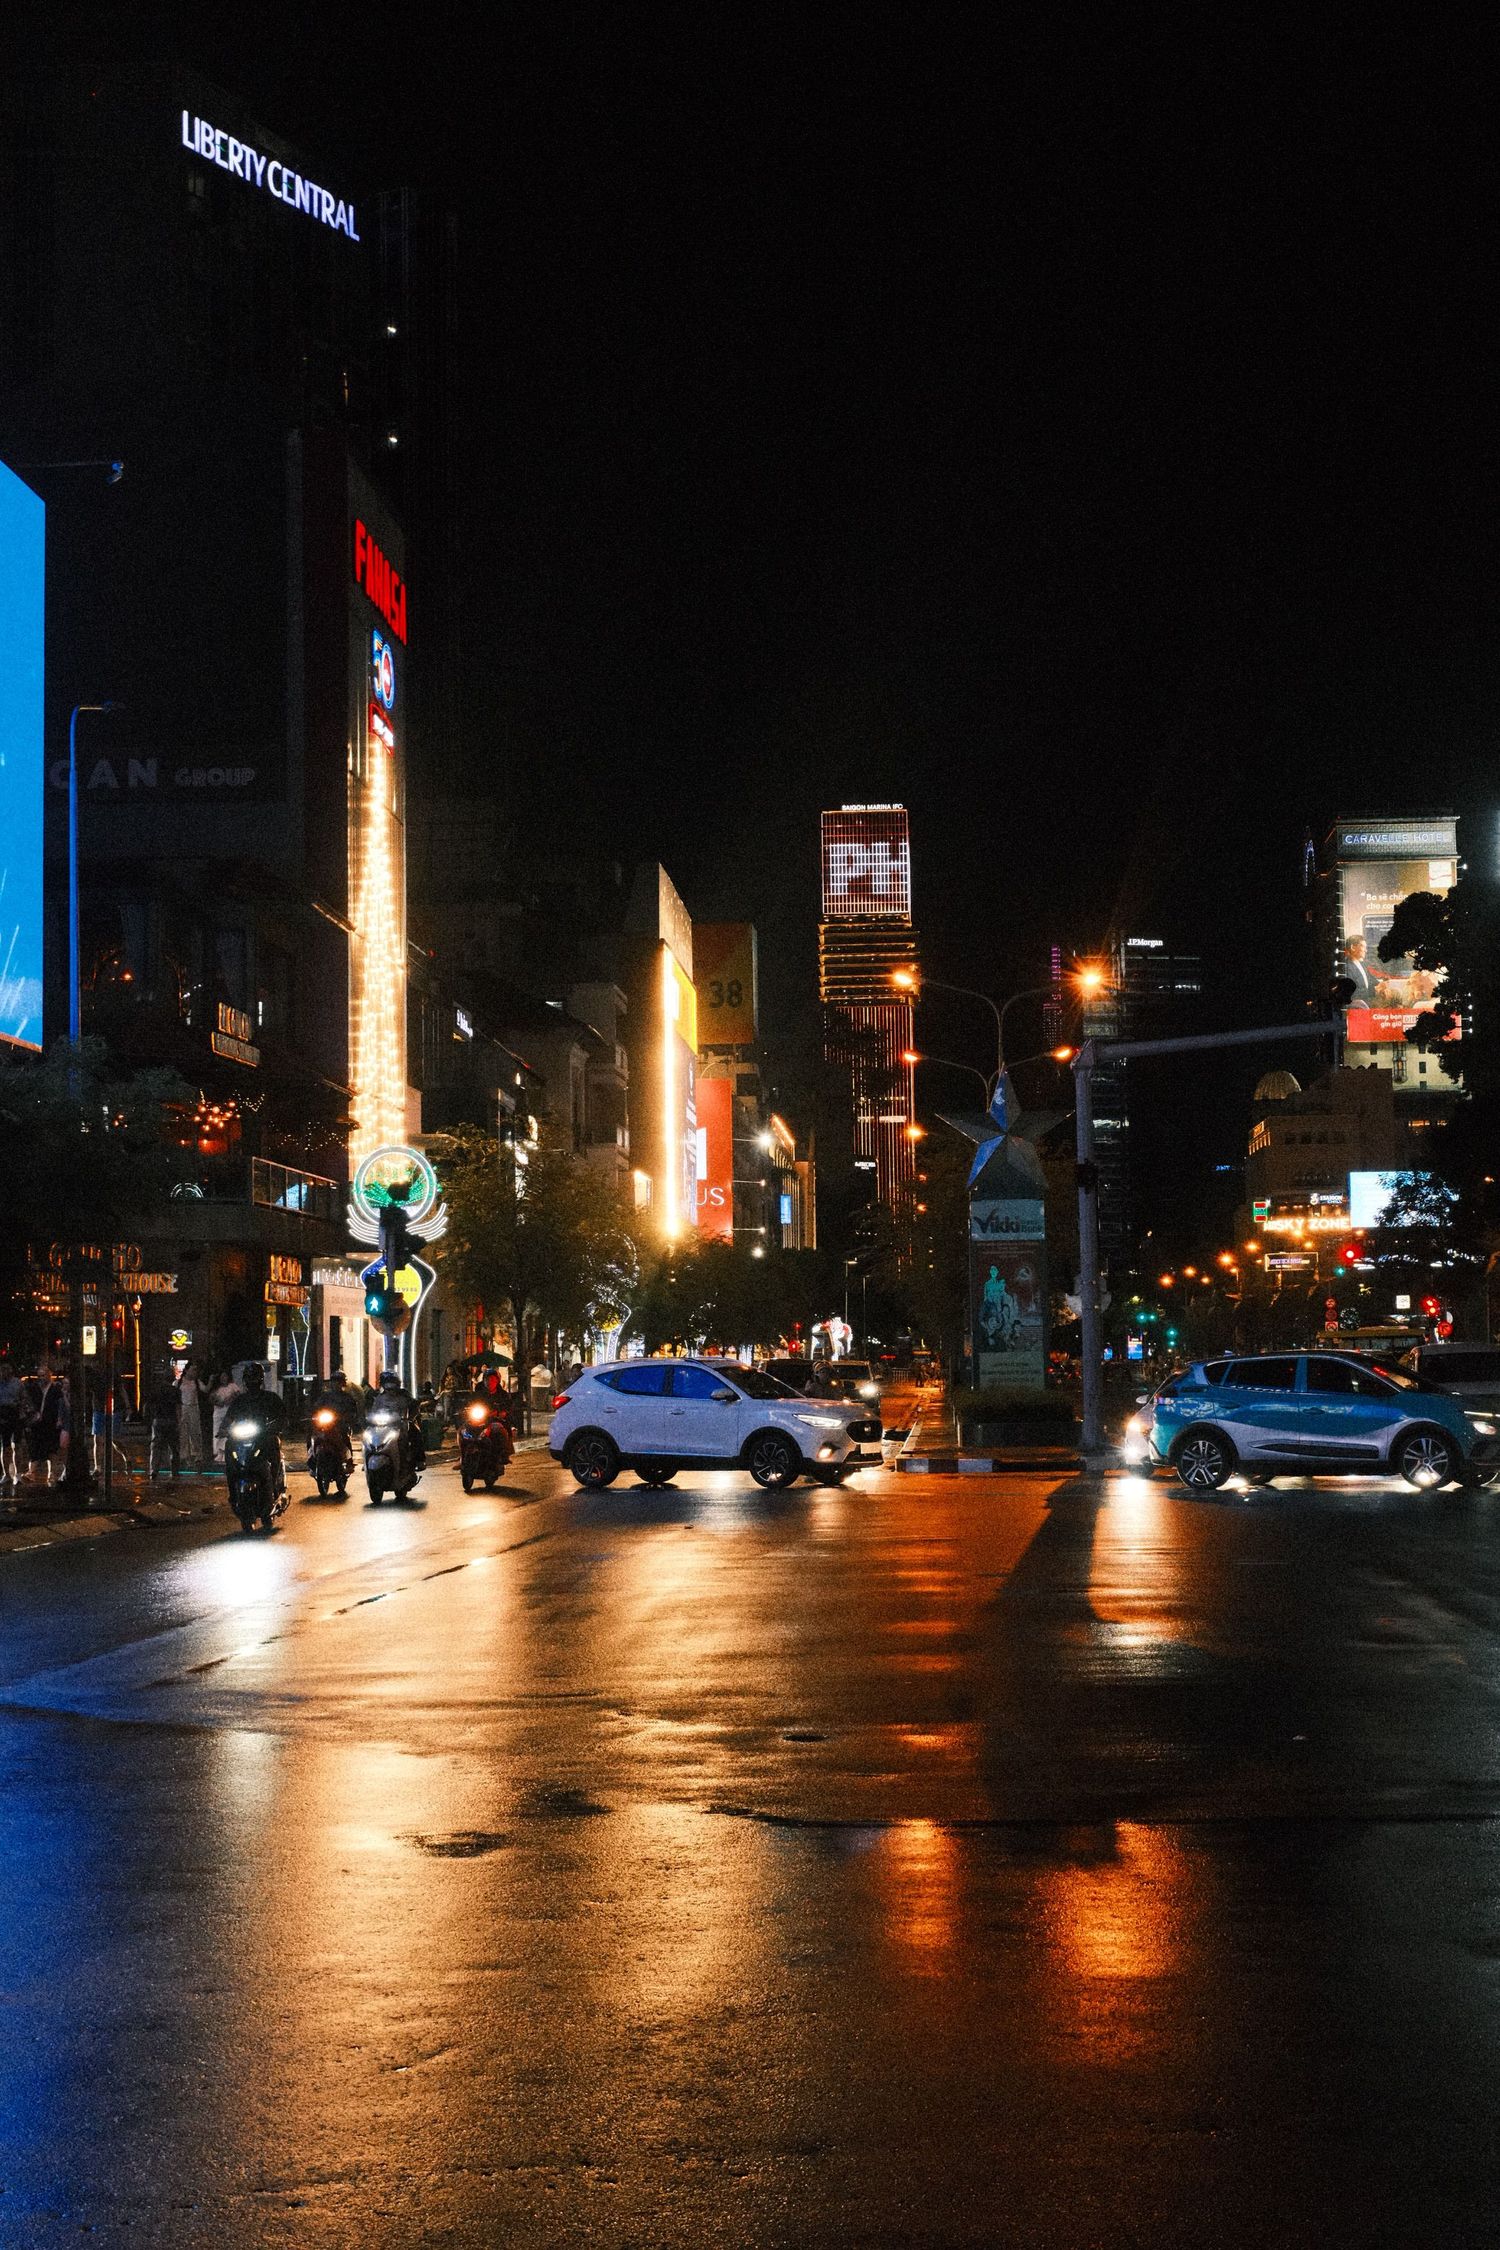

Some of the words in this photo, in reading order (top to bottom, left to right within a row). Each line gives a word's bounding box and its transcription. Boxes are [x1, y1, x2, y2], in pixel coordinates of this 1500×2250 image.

[182, 109, 267, 187] LIBERTY
[267, 160, 360, 242] CENTRAL
[174, 767, 256, 787] GROUP
[1344, 833, 1408, 844] CARAVELLE
[1413, 832, 1449, 843] HOTEL
[709, 979, 743, 1009] 38
[1308, 1218, 1349, 1230] ZONE
